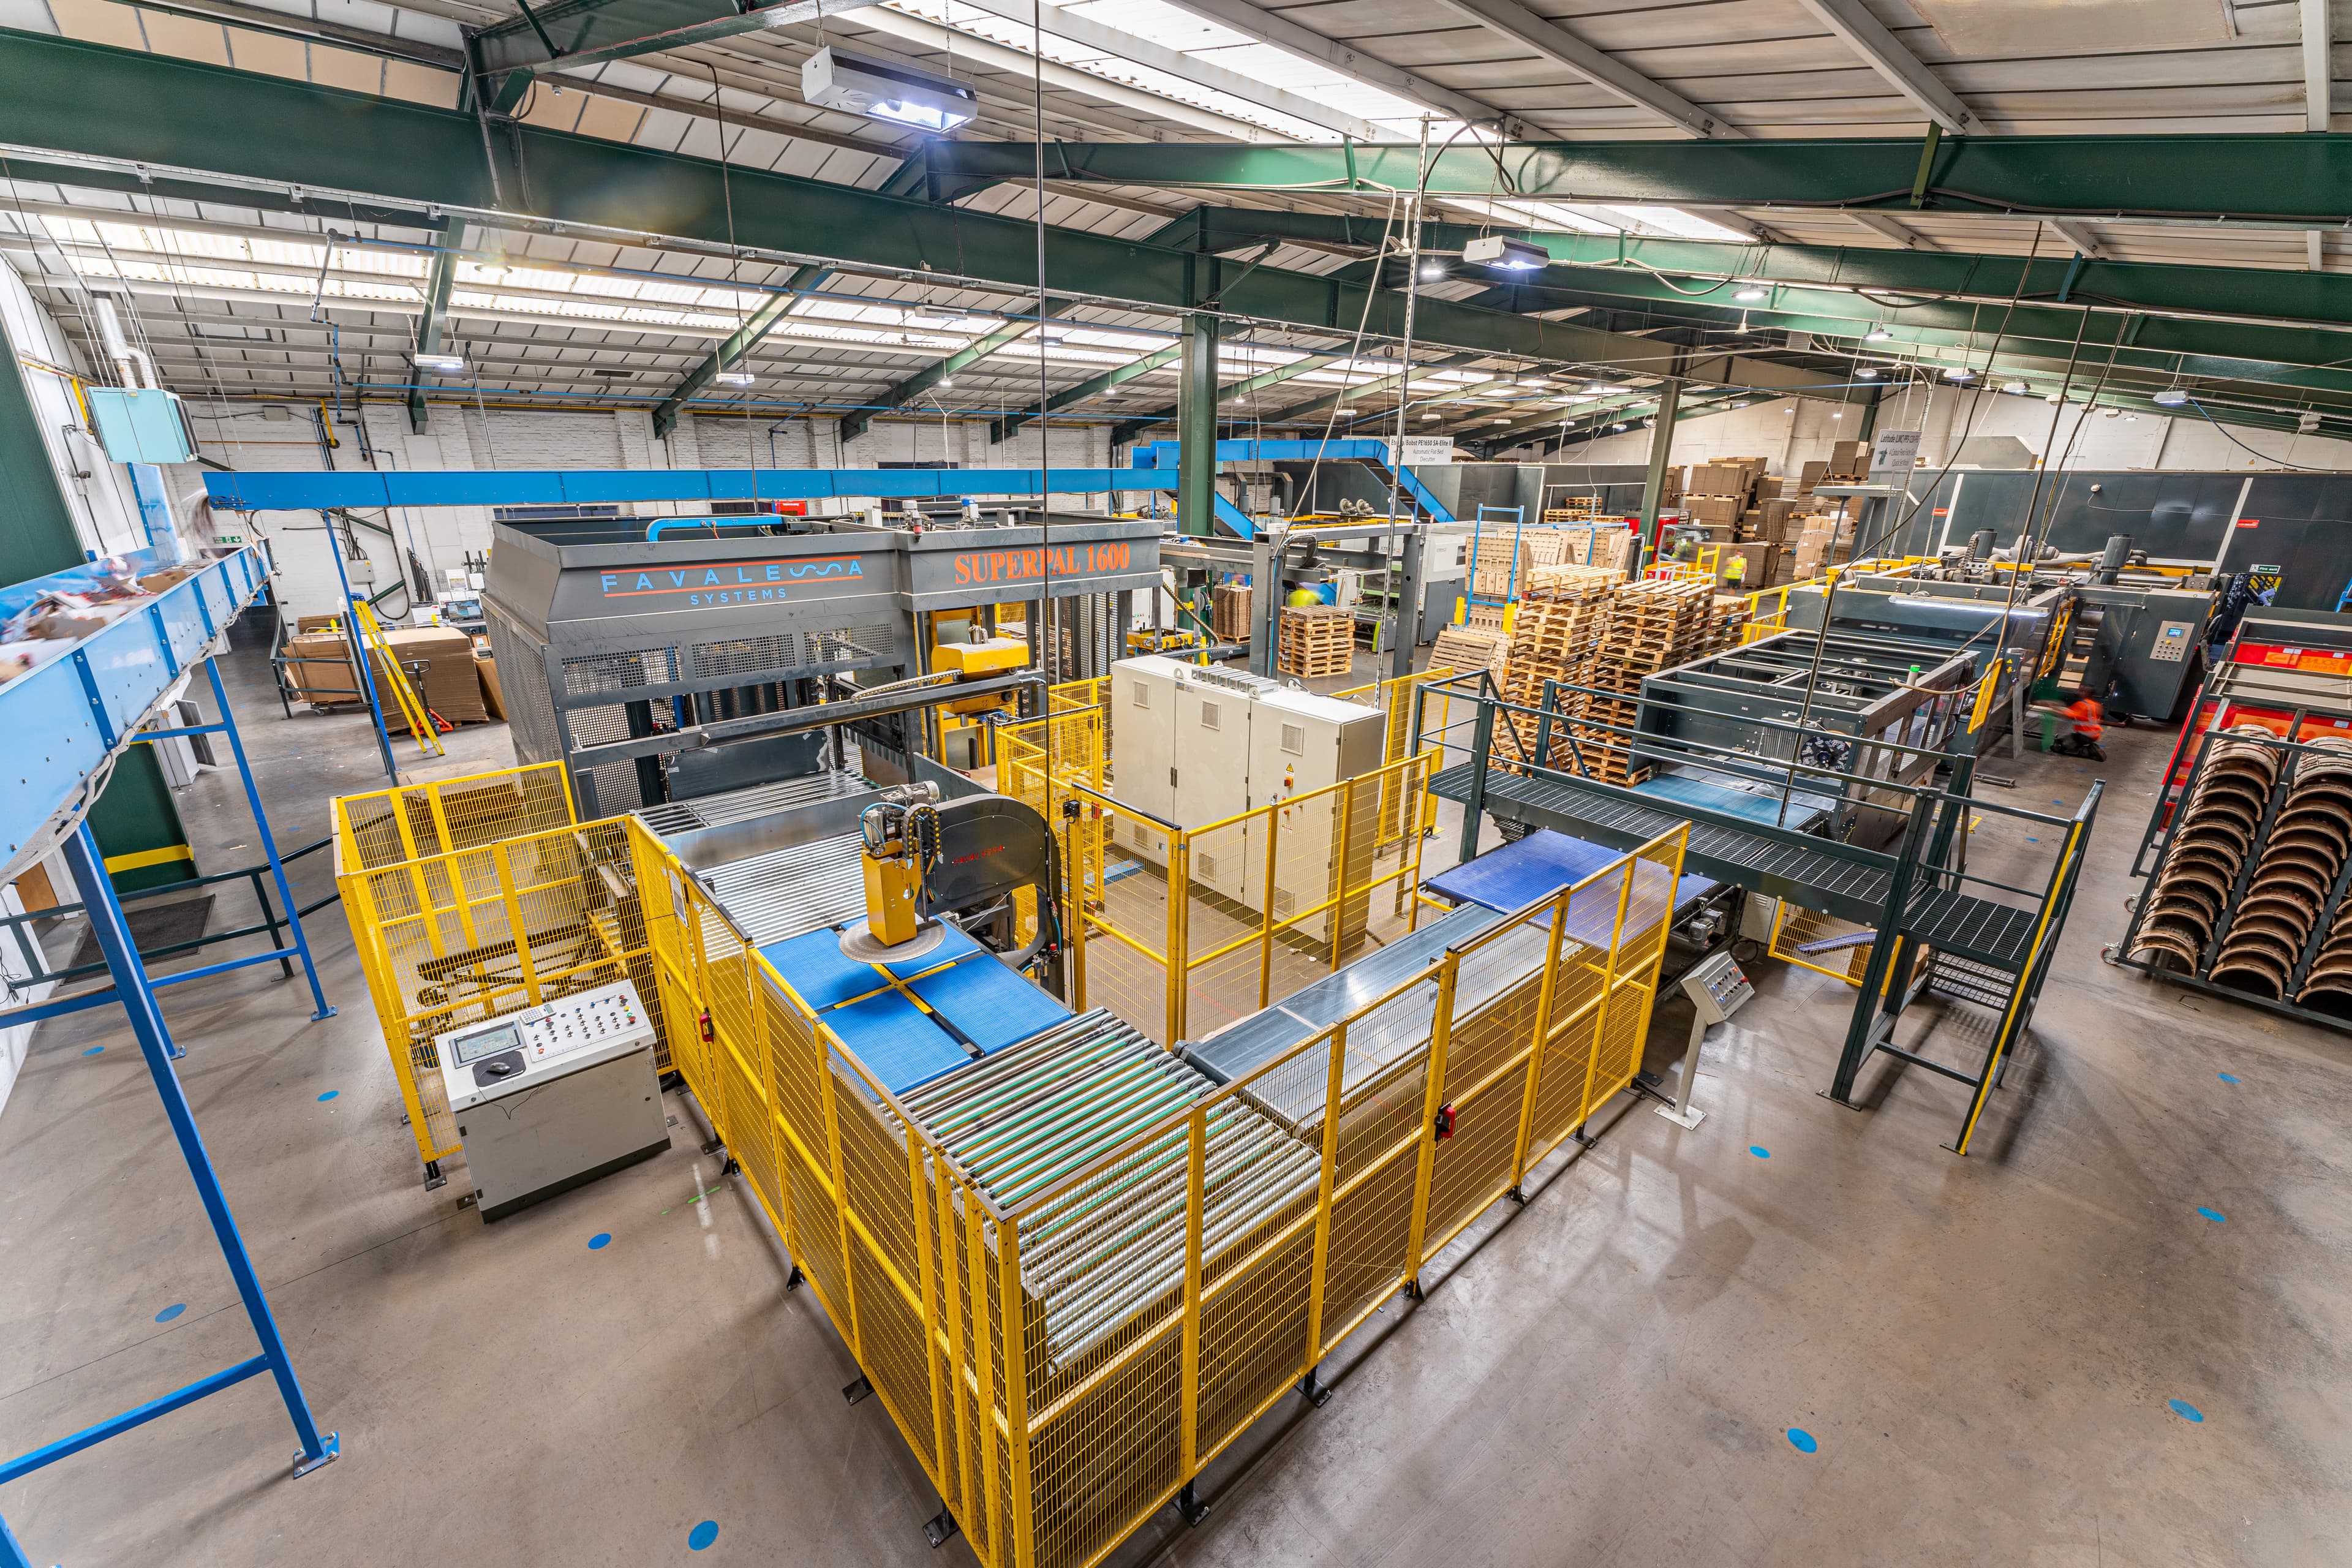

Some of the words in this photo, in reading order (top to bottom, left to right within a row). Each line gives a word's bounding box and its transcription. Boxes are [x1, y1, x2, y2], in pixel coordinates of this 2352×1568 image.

[954, 547, 1080, 584] SUPERPAL
[1087, 543, 1130, 572] 1600
[690, 588, 786, 605] SYSTEMS
